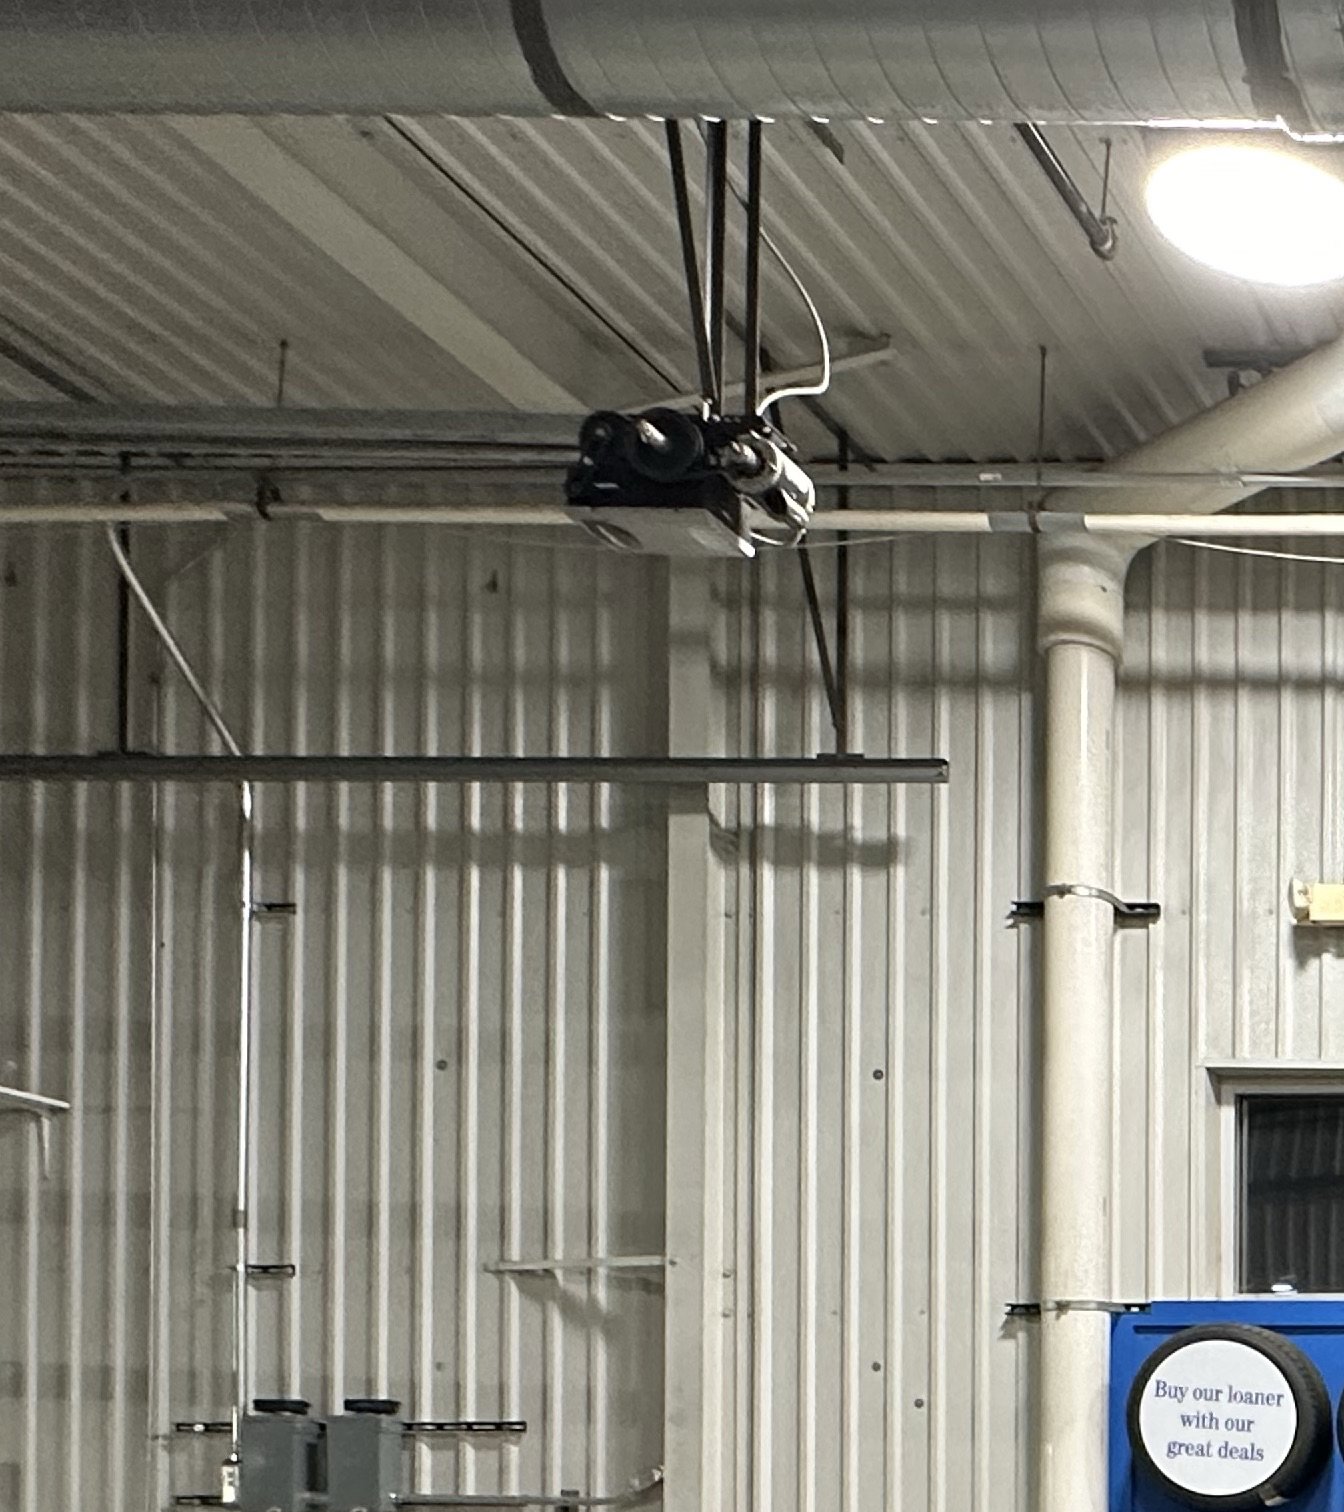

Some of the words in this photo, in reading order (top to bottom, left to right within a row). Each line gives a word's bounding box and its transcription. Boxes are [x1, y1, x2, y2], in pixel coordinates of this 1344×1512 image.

[1154, 1380, 1189, 1403] Buy
[1192, 1386, 1223, 1402] our
[1227, 1384, 1285, 1407] loaner
[1180, 1411, 1220, 1430] with
[1224, 1417, 1255, 1432] our
[1166, 1440, 1213, 1459] great
[1217, 1440, 1264, 1461] deals
